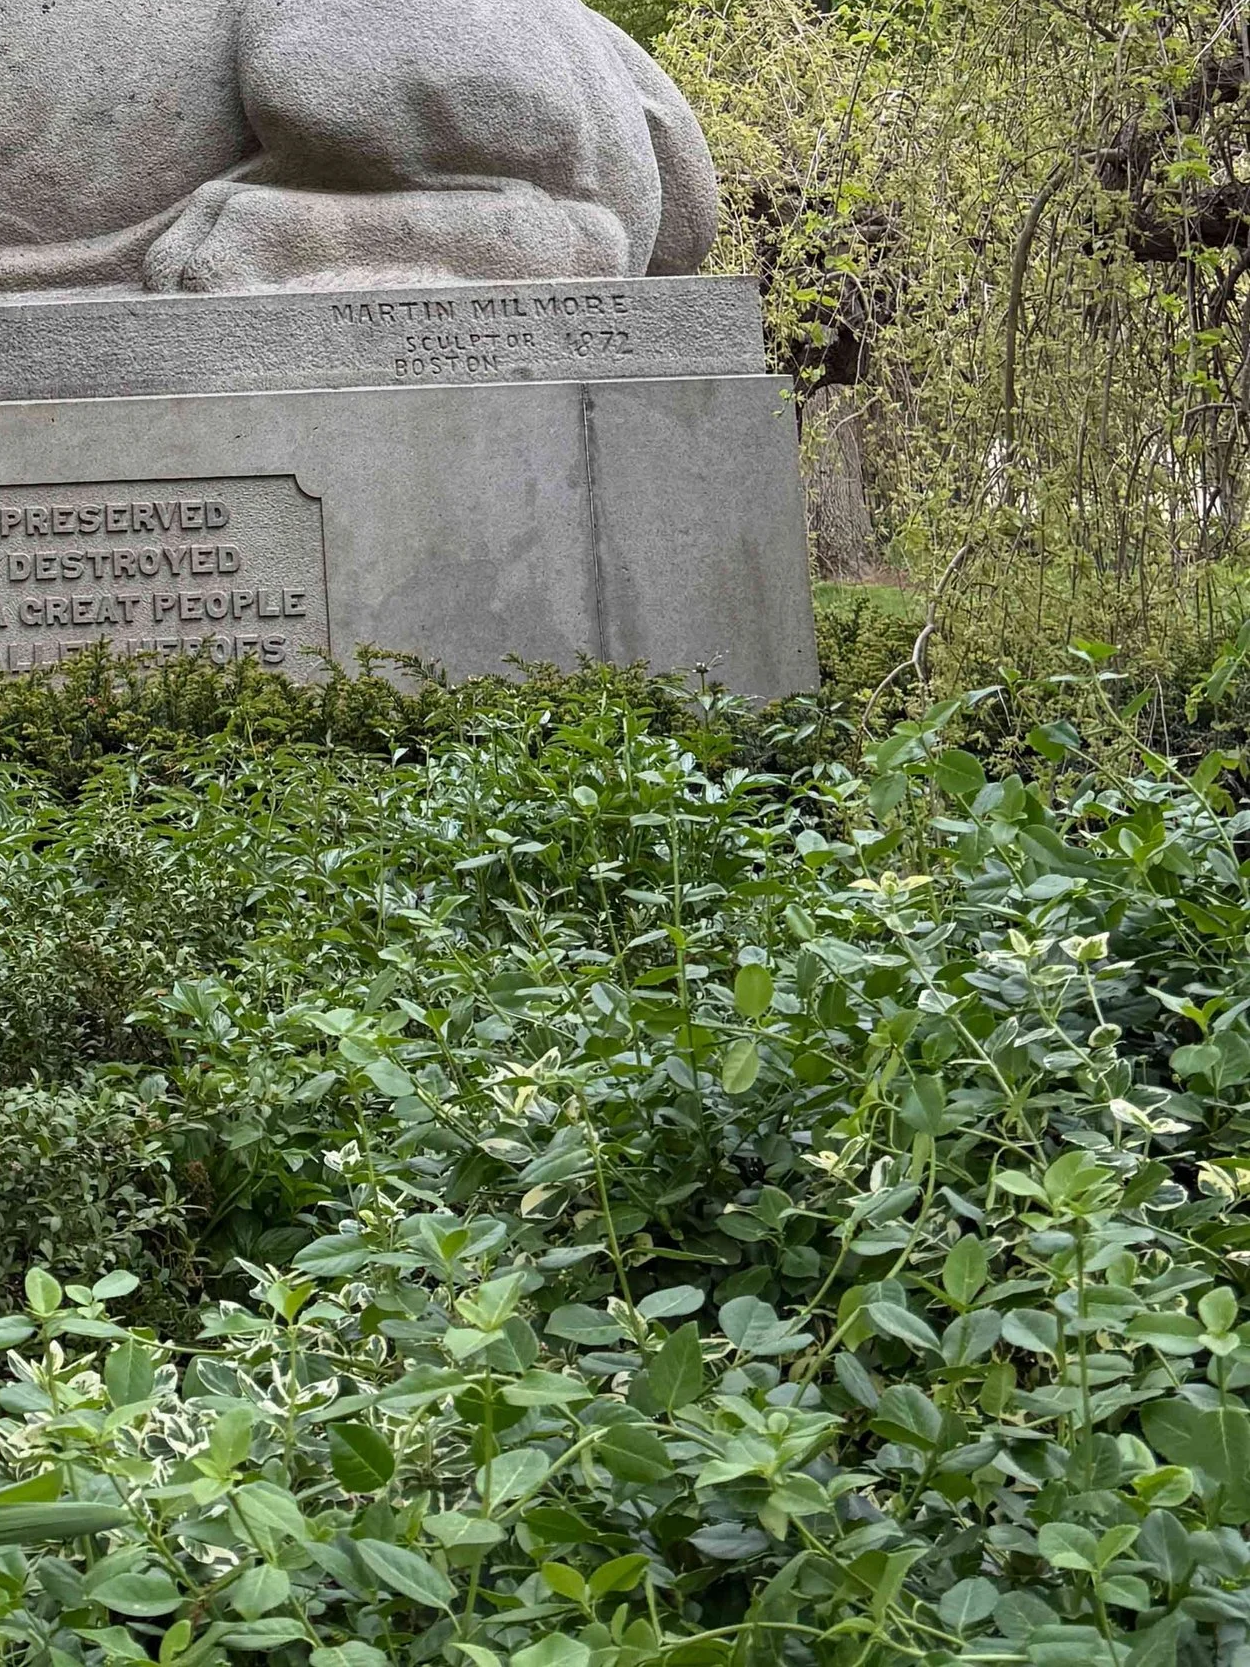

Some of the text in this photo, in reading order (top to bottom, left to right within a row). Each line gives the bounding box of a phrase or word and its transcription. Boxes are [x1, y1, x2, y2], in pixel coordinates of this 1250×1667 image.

[332, 295, 628, 324] MARTIN MILMORE
[407, 330, 634, 357] SCULPTOR 1872
[395, 355, 499, 377] BOSTON
[0, 499, 230, 539] PRESERVED
[7, 544, 242, 581] DESTROYED
[19, 594, 141, 626] GREAT
[153, 588, 308, 622] PEOPLE
